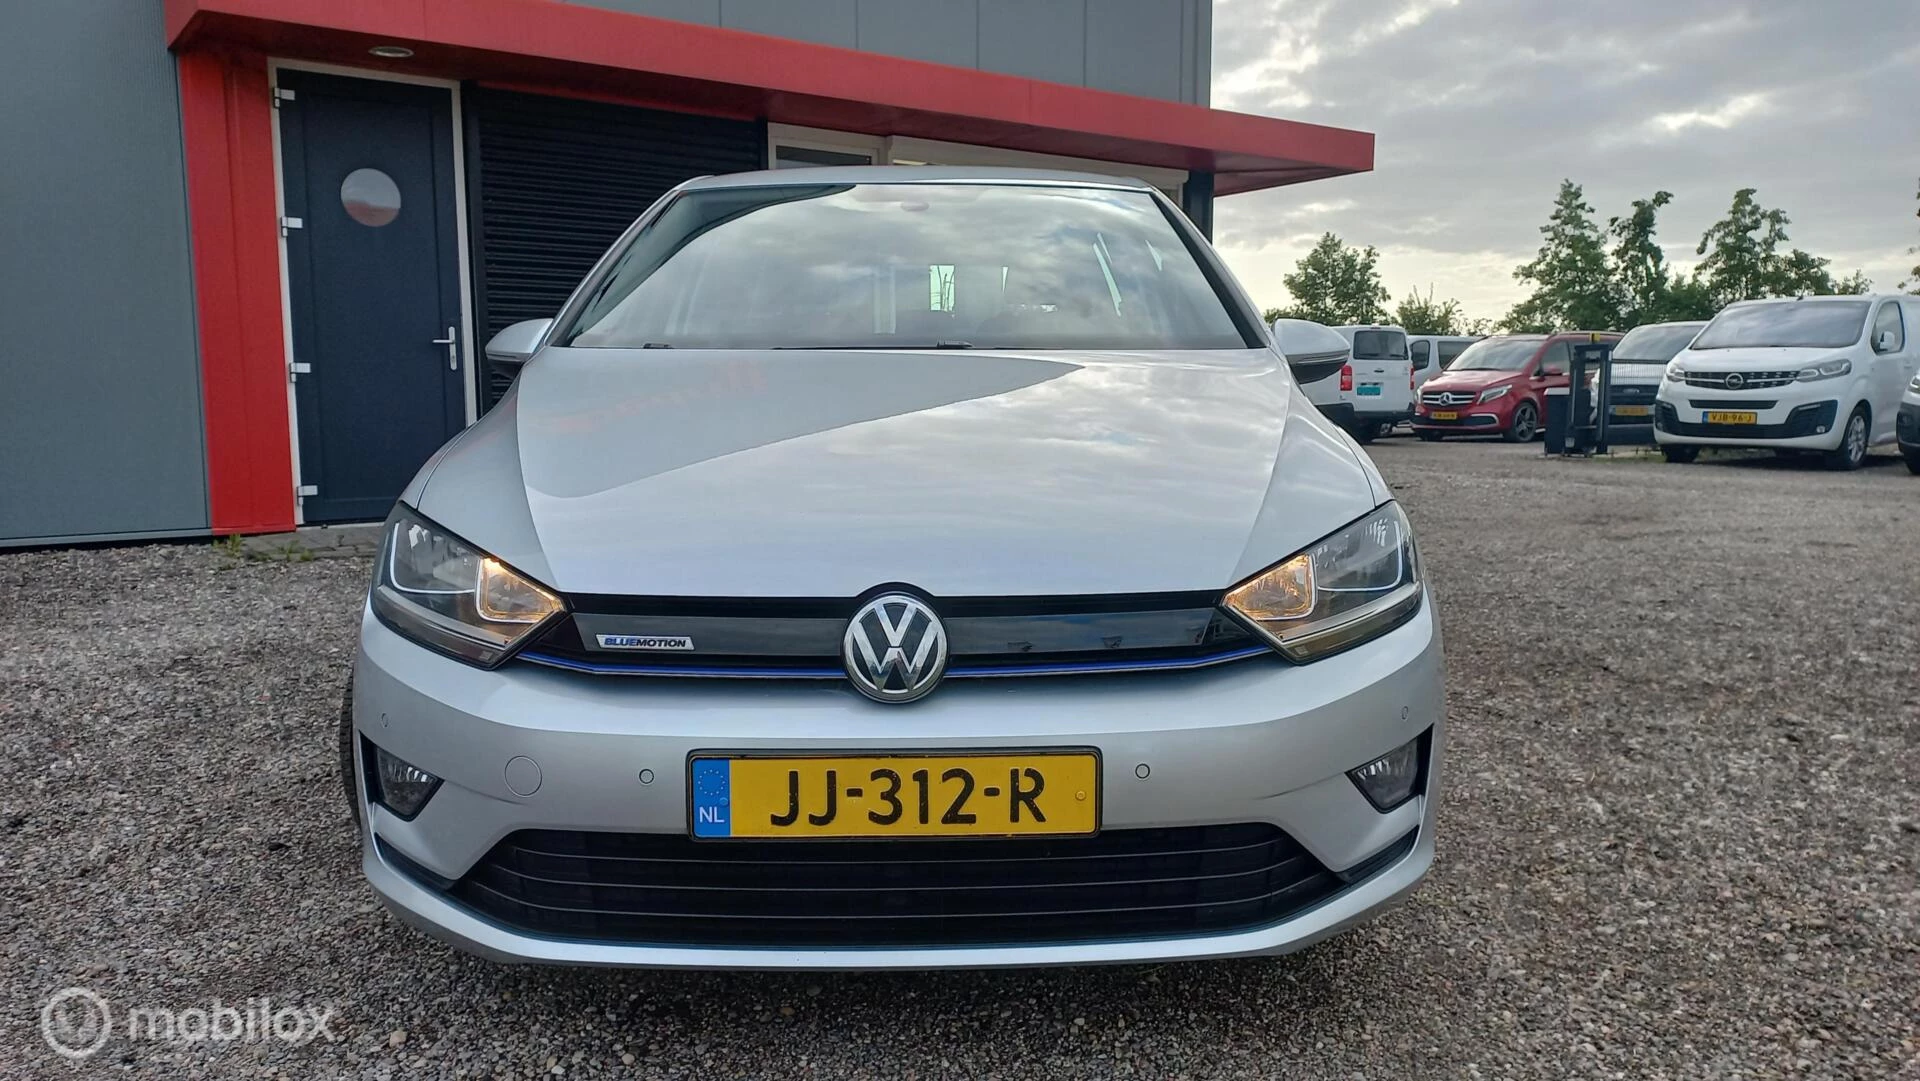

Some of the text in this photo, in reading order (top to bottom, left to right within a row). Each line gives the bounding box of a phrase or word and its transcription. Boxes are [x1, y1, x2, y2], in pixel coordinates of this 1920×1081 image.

[604, 637, 687, 648] BLUEMOTION
[770, 767, 1047, 826] JJ-312-R
[699, 806, 725, 823] NL
